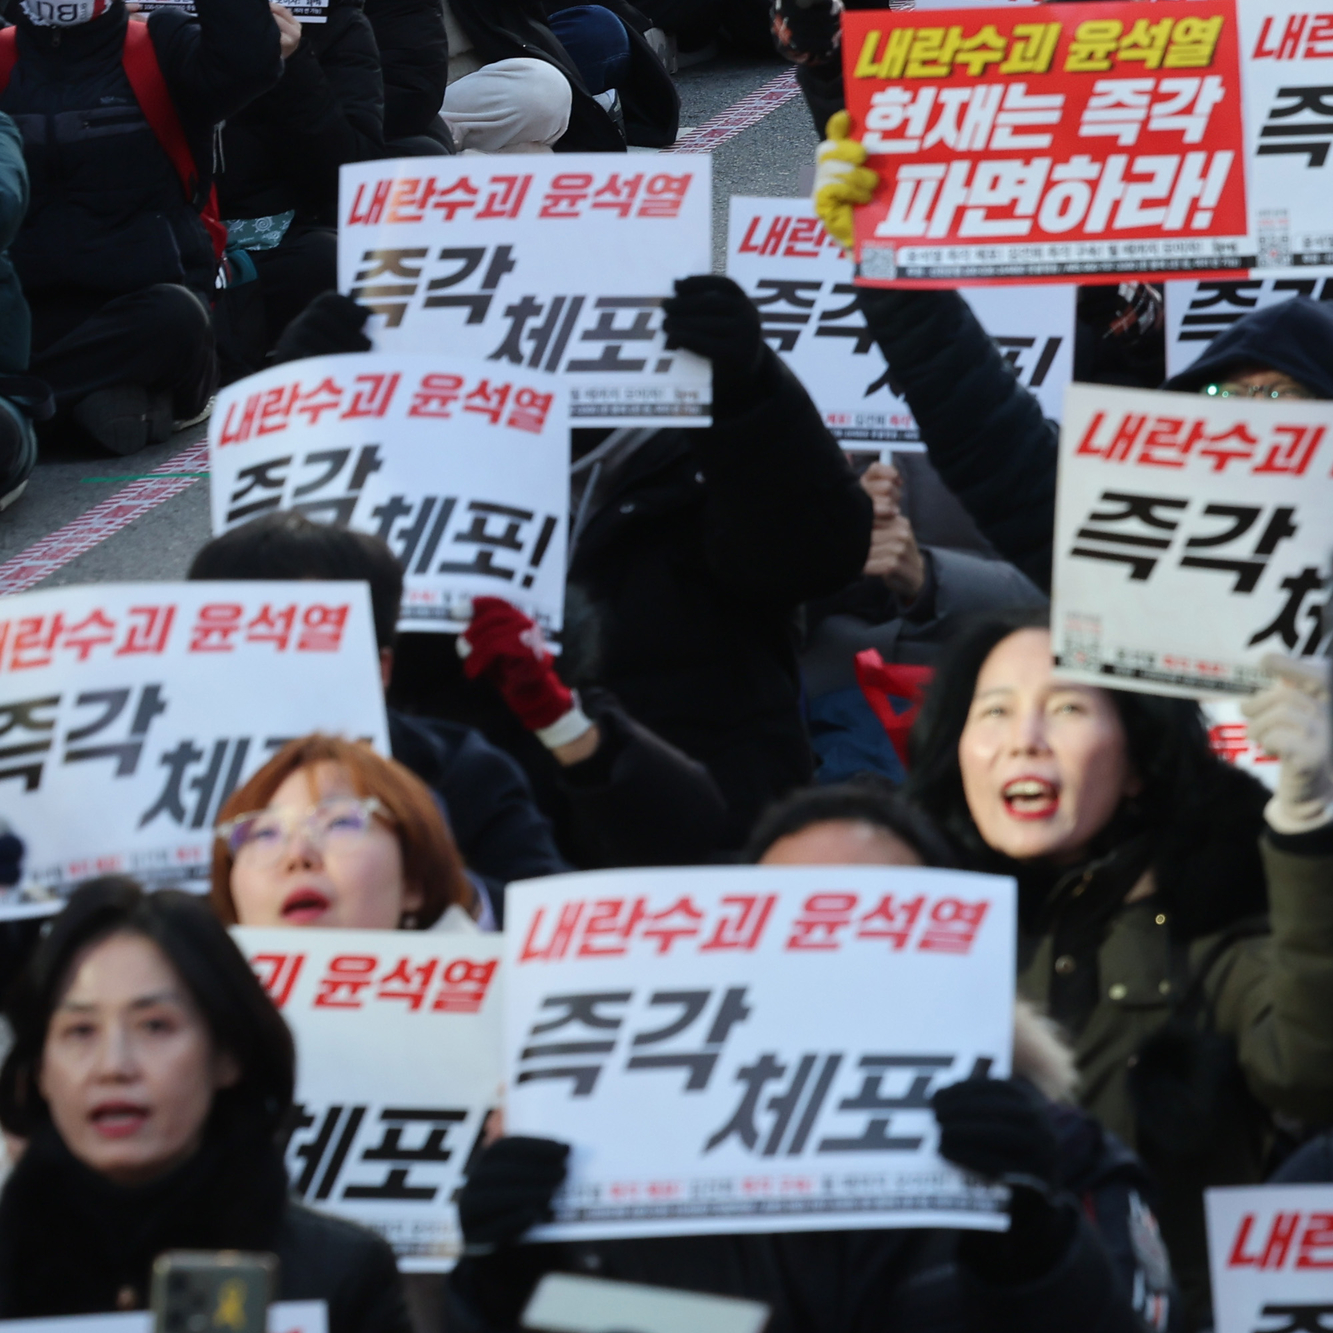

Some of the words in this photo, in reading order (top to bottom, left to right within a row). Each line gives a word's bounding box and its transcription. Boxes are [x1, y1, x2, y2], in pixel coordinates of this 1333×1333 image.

[855, 23, 1062, 78] 내란수괴
[1068, 16, 1223, 70] 윤석열
[855, 83, 1064, 162] 헌재는
[1079, 76, 1225, 145] 즉각
[874, 151, 1234, 239] 파면하라!
[519, 894, 777, 963] 내란수괴
[786, 893, 989, 952] 윤석열
[515, 987, 751, 1096] 즉각
